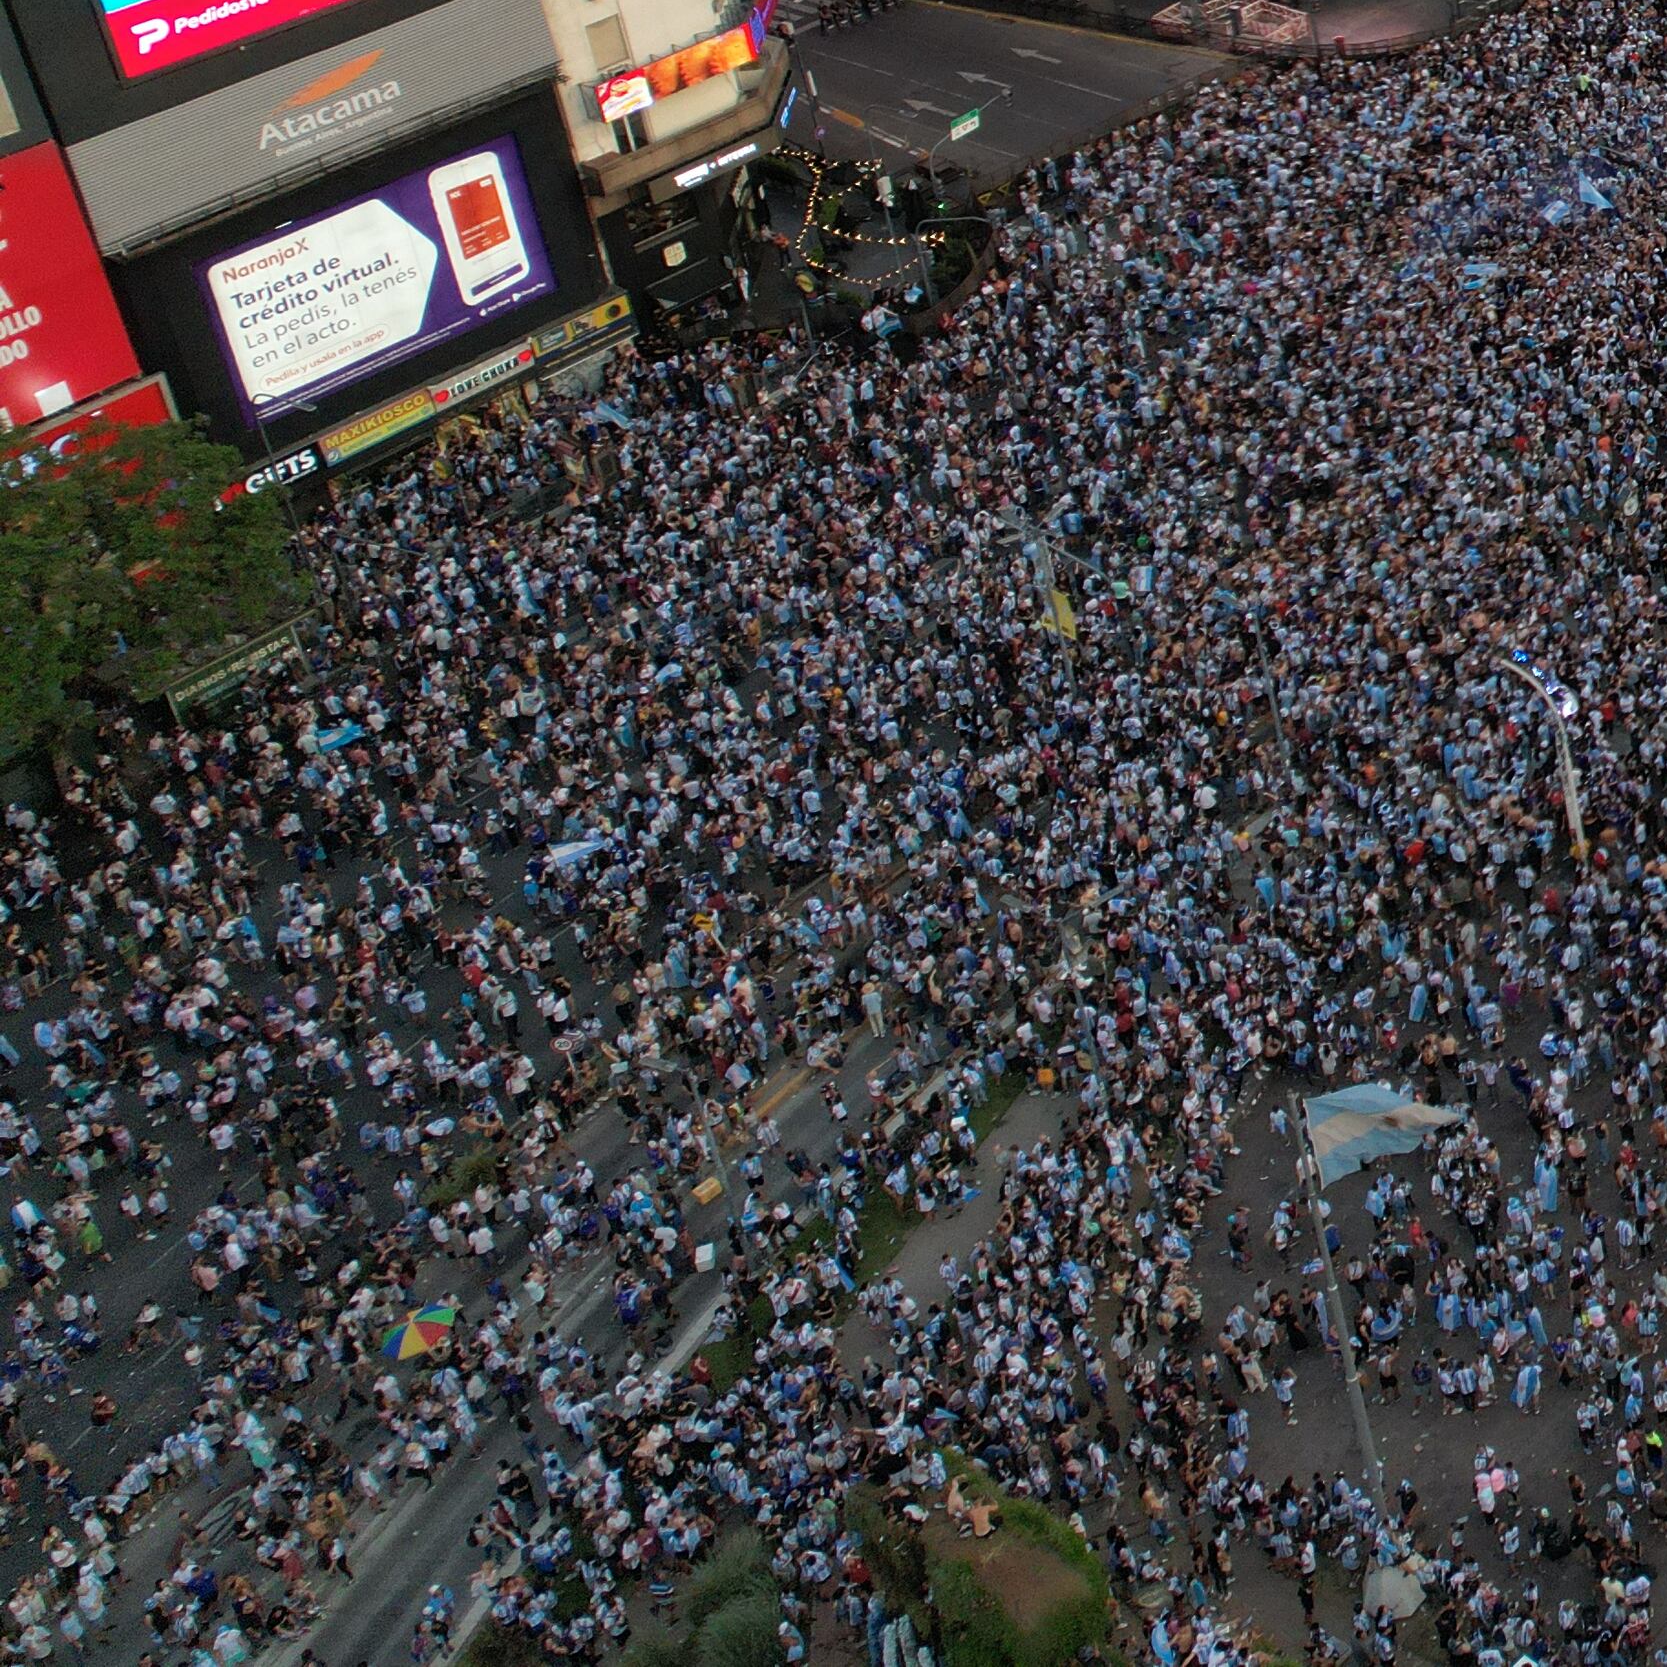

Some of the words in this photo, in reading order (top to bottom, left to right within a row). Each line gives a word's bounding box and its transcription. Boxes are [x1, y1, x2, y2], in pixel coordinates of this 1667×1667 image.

[259, 80, 402, 150] Atacama
[230, 269, 308, 310] Tarjeta
[312, 255, 341, 277] de
[239, 287, 318, 329] crédito
[321, 252, 400, 293] virtual.
[244, 332, 268, 350] La
[273, 301, 338, 342] pedís,
[341, 293, 360, 309] la
[363, 265, 417, 298] tenés
[252, 350, 279, 368] en
[283, 335, 303, 355] el
[307, 317, 357, 346] acto.
[338, 344, 352, 357] en
[364, 329, 386, 346] app
[449, 376, 480, 399] LOVE
[323, 393, 427, 451] MAXIKIOSCO
